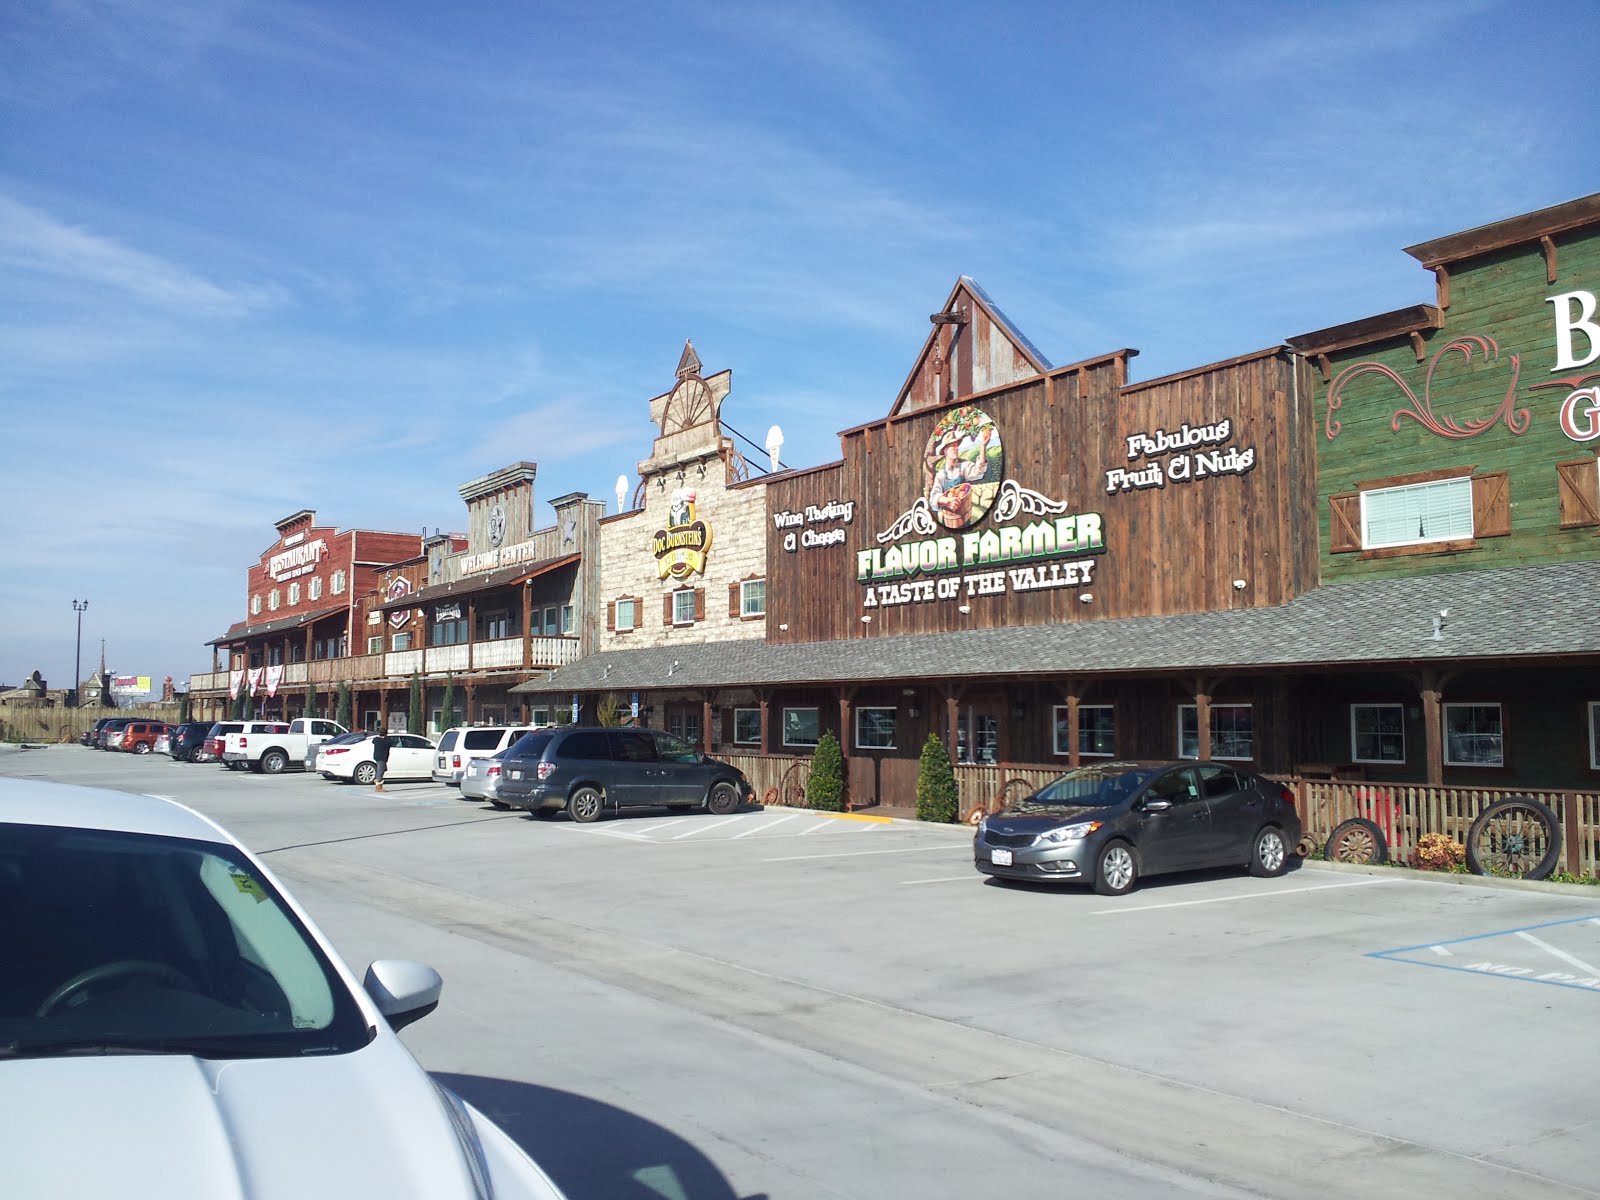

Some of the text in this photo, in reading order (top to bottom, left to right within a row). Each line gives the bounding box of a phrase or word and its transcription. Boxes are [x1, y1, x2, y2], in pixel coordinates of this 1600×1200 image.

[1127, 419, 1231, 458] Fabulous
[1106, 447, 1255, 491] Fruit & Nuts
[773, 501, 855, 529] Wine Tasting
[269, 538, 325, 580] RESTAURANT
[461, 540, 536, 576] WELCOME CENTER
[783, 528, 846, 551] & Cheese
[857, 512, 1104, 581] FLAVOR FARMER
[863, 559, 1095, 607] A TASTE OF THE VALLEY
